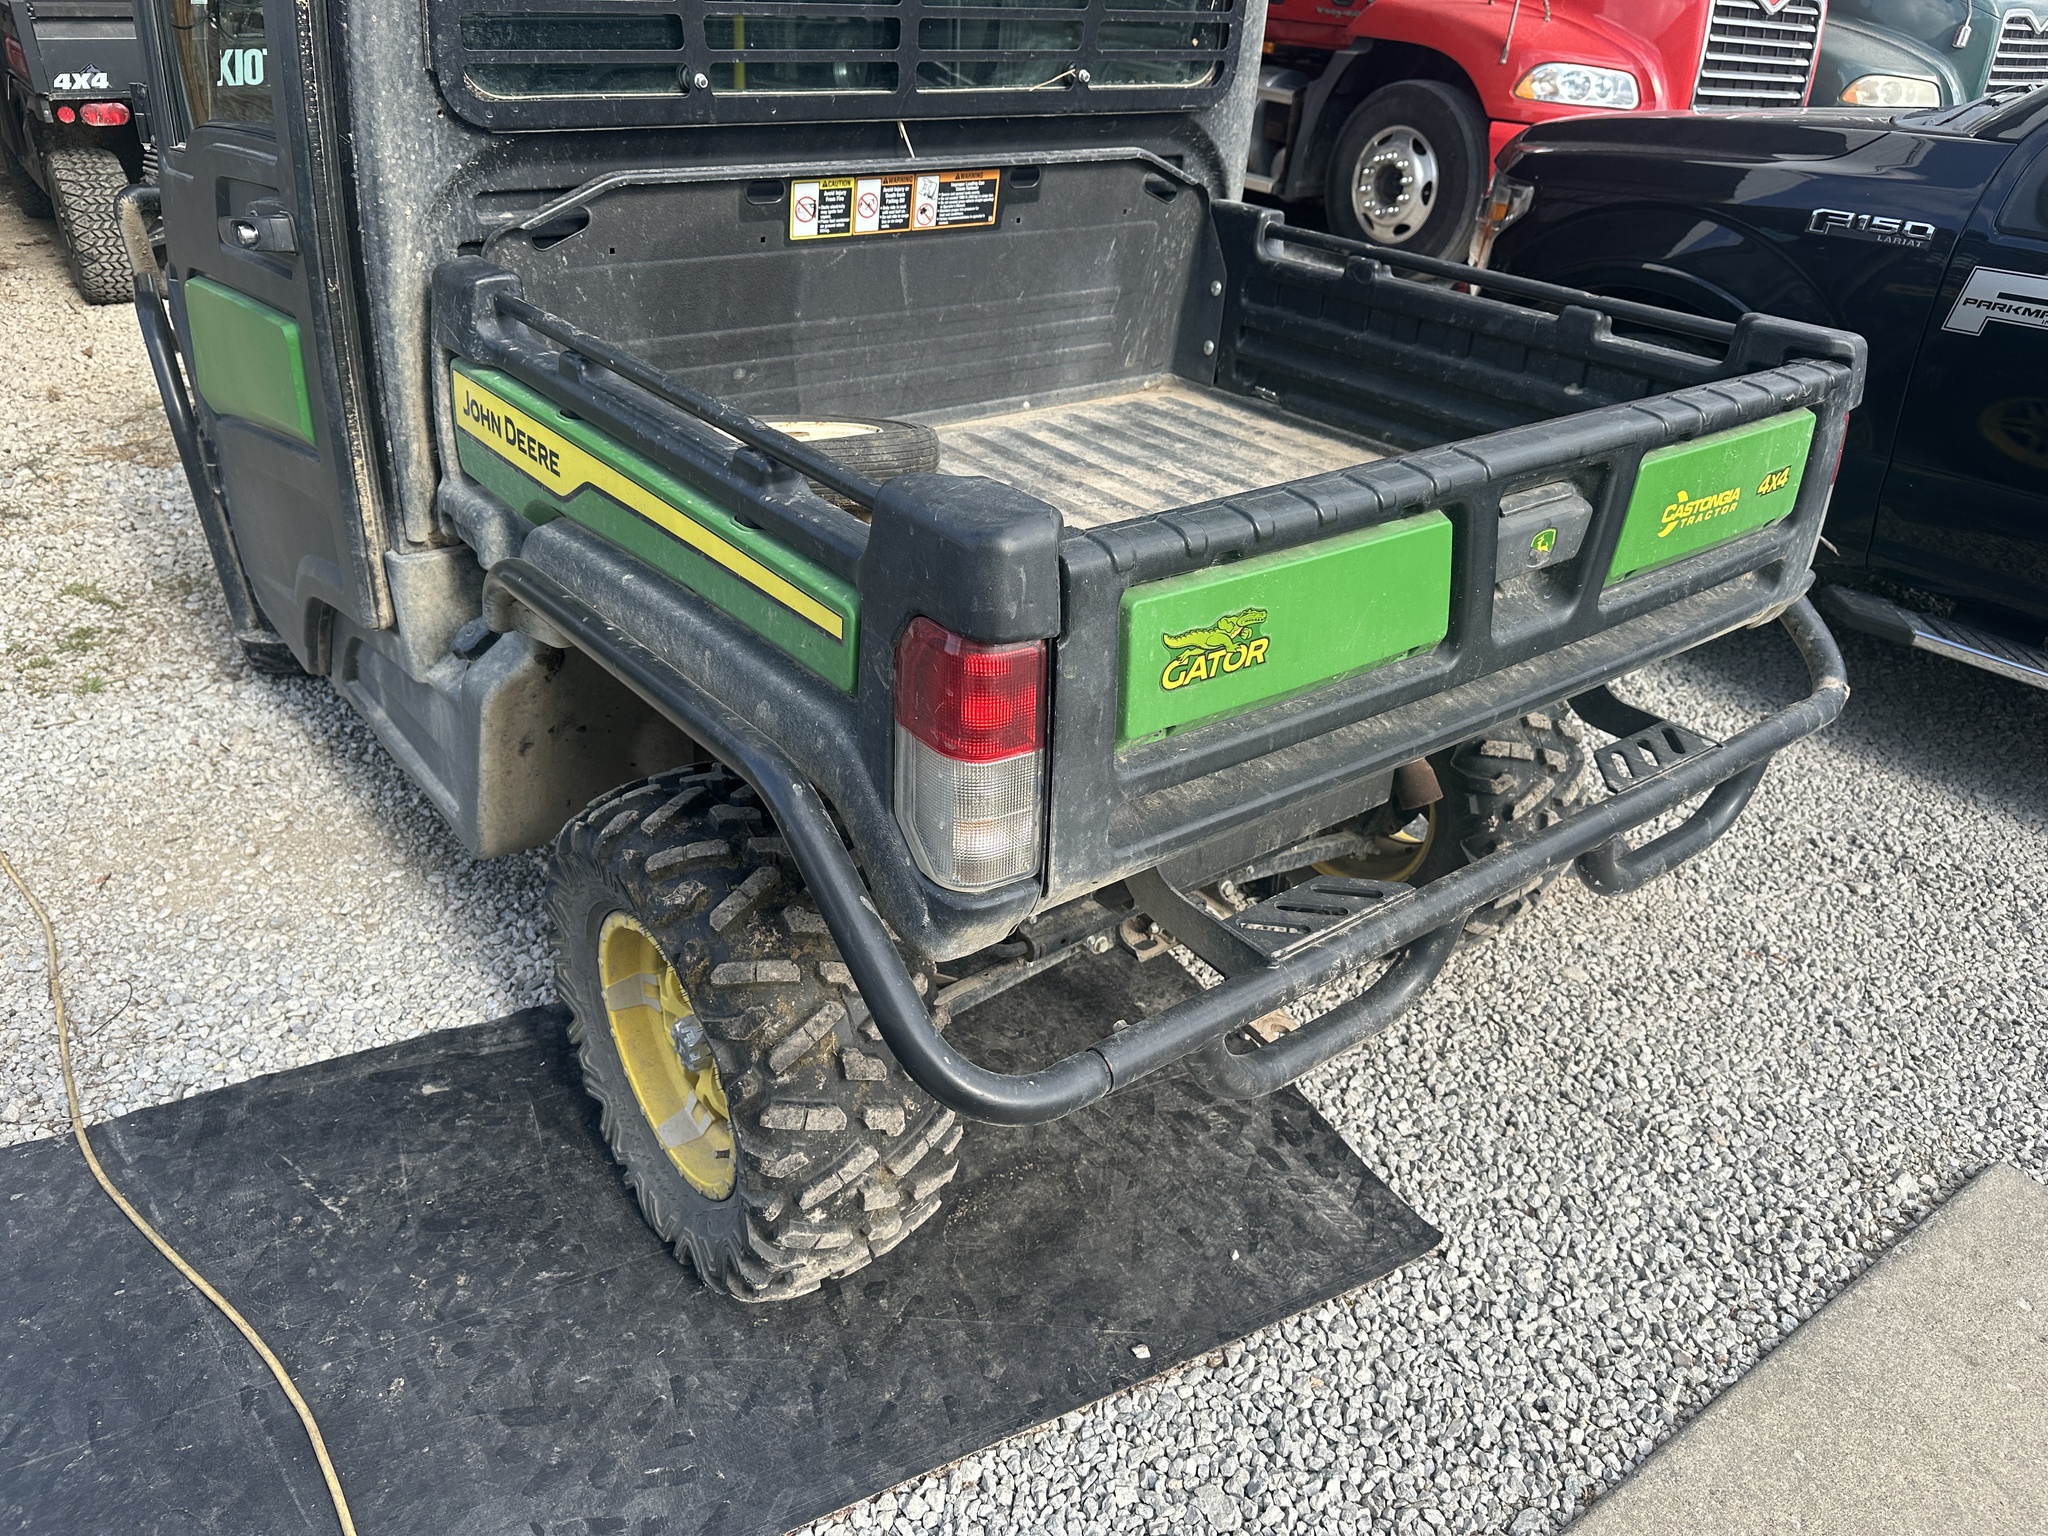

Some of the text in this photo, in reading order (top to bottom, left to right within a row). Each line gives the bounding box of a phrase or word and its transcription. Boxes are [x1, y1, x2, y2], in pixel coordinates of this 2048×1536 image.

[217, 48, 268, 87] KIO
[828, 179, 851, 188] CAUTION
[888, 176, 913, 184] WARNING
[960, 172, 984, 180] WARNING
[1877, 235, 1924, 248] LARIAT
[463, 390, 561, 478] JOHN DEERE
[1661, 487, 1741, 524] CASTONGIA
[1680, 502, 1739, 528] TRACTOR
[1162, 637, 1270, 691] GATOR
